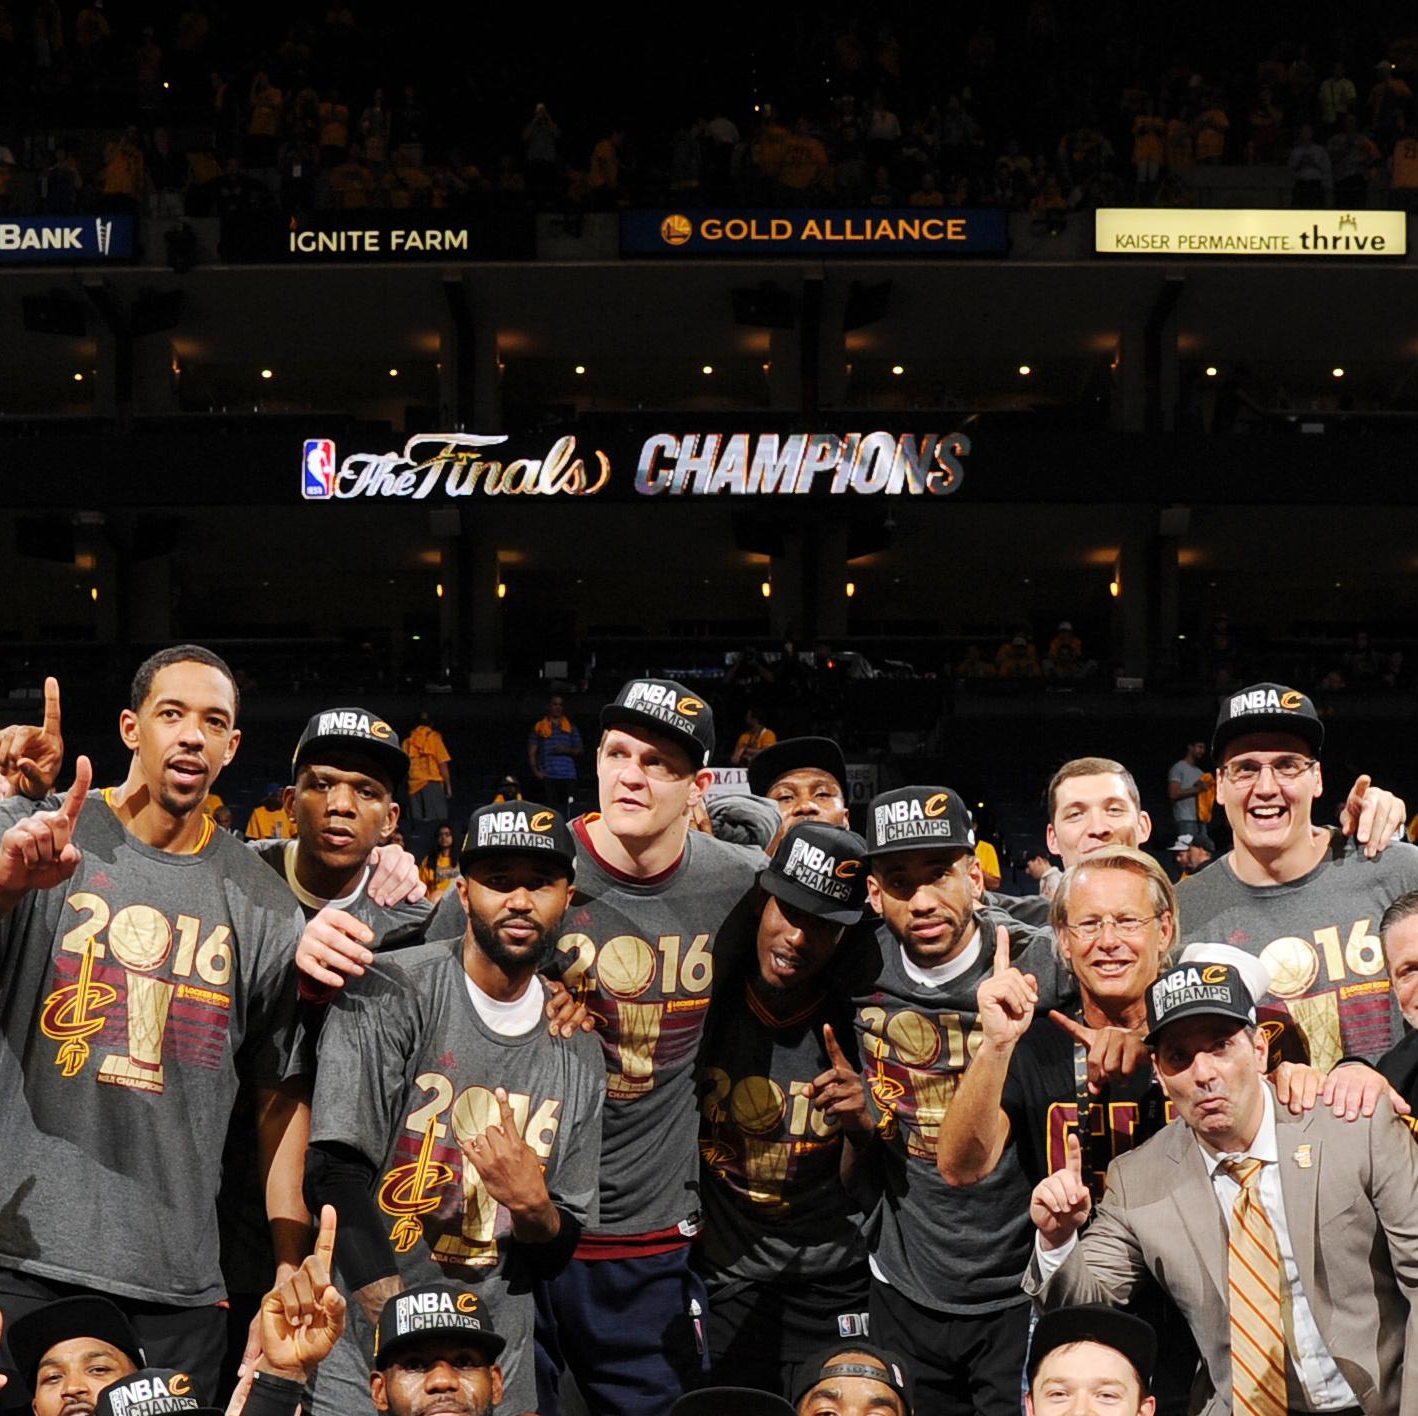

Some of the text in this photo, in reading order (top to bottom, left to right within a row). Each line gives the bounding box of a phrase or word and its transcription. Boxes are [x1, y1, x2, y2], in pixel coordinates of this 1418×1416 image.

[0, 224, 83, 250] BANK
[290, 229, 469, 252] IGNITE FARM
[700, 217, 967, 241] GOLD ALLIANCE
[1115, 224, 1386, 251] KAISER PERMANENTE thrive
[334, 432, 611, 499] The Finals
[634, 432, 972, 495] CHAMPIONS
[637, 682, 678, 712] NBA
[1240, 689, 1281, 711] NBA
[331, 712, 370, 734] NBA
[637, 701, 695, 735] CHAMPS
[489, 812, 530, 832] NBA
[885, 800, 925, 824] NBA
[487, 832, 555, 849] CHAMPS
[885, 820, 952, 841] CHAMPS
[796, 842, 836, 878] NBA
[794, 862, 852, 902] CHAMPS
[1258, 918, 1385, 999] 016
[1159, 967, 1203, 996] NBA
[1162, 985, 1233, 1012] CHAMPS
[409, 1292, 456, 1314] NBA
[410, 1312, 482, 1333] CHAMPS
[122, 1376, 170, 1406] NBA
